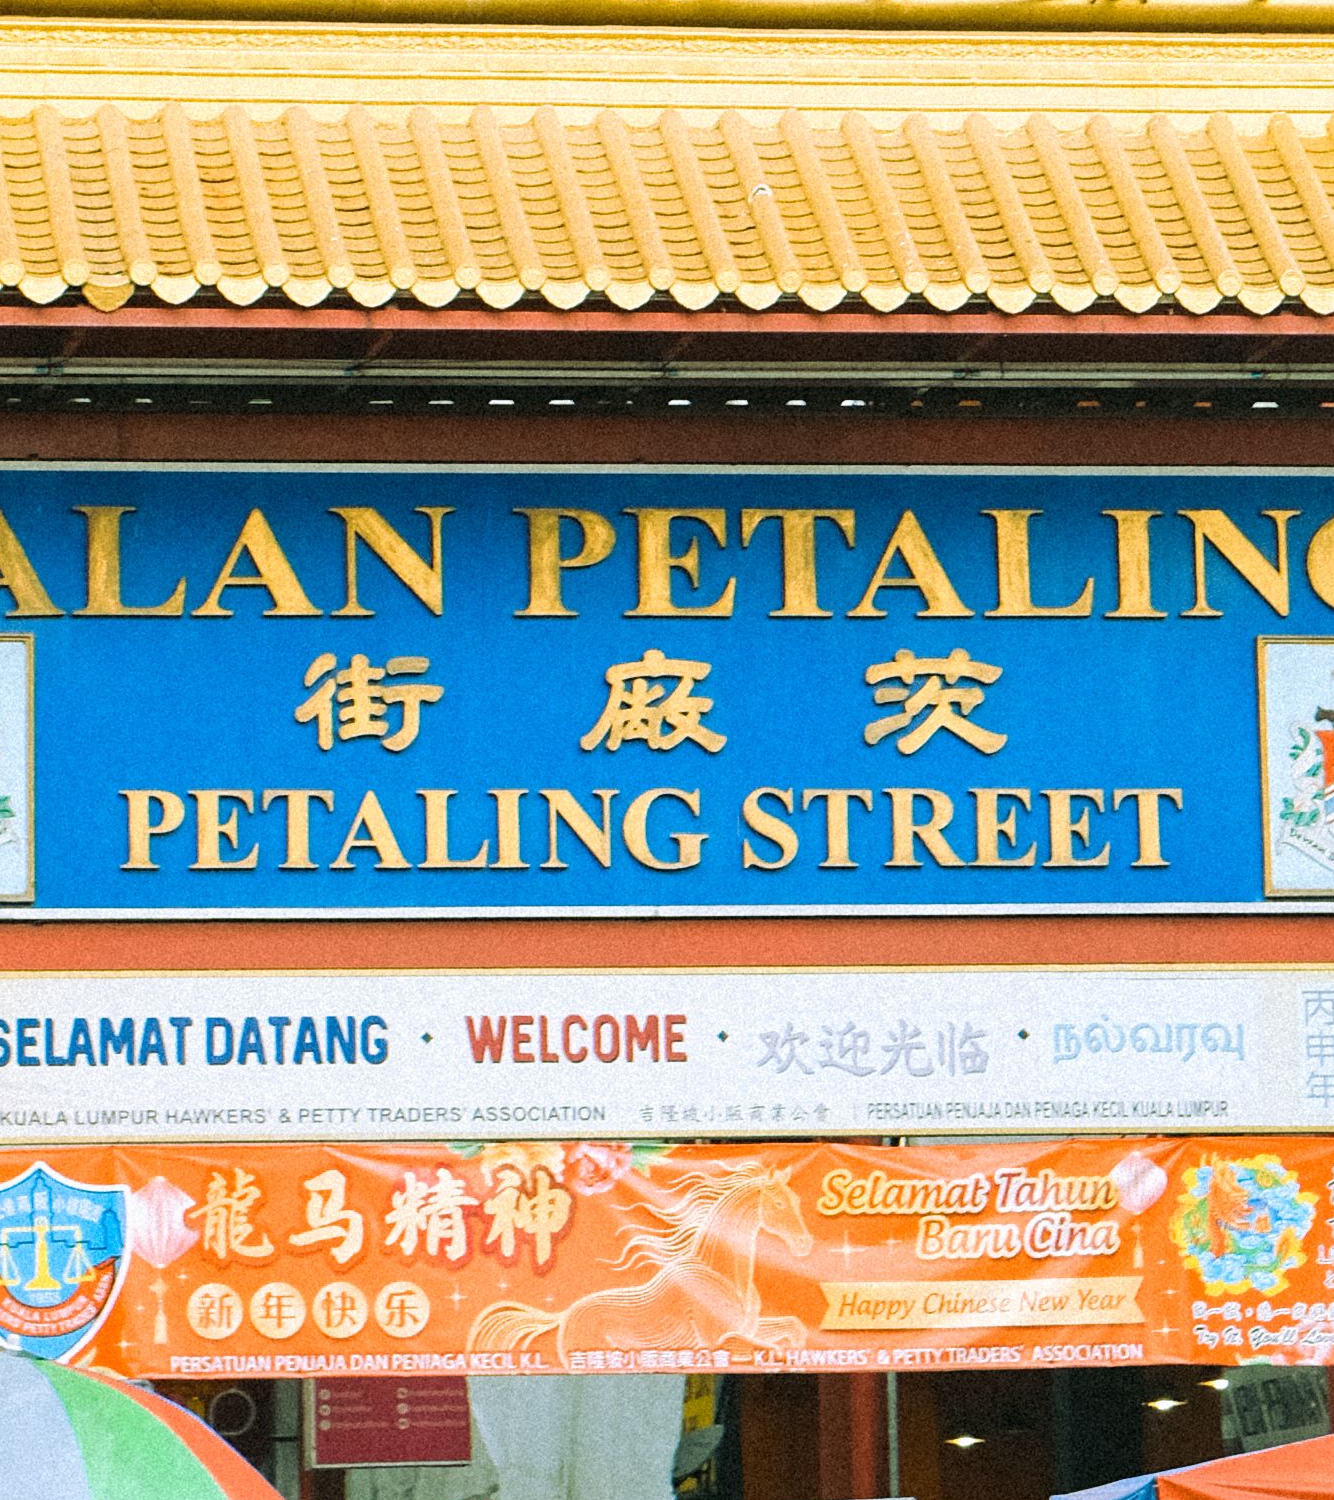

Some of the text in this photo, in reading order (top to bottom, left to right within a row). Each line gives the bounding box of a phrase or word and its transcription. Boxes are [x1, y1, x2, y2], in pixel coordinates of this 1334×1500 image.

[120, 784, 1184, 872] PETALING STREET
[204, 1014, 389, 1066] DATANG
[466, 1013, 689, 1064] WELCOME
[756, 1018, 990, 1078] 欢迎光临
[1052, 1013, 1245, 1063] நல்வரவு
[0, 1109, 69, 1127] KUALA
[74, 1108, 159, 1126] LUMPUR
[278, 1107, 291, 1124] &
[298, 1107, 361, 1124] PETTY
[471, 1104, 607, 1122] ASSOCIATION
[867, 1102, 943, 1121] PERSATUAN
[946, 1102, 1001, 1120] PENJAJA
[1004, 1102, 1031, 1120] DAN
[1034, 1101, 1090, 1120] PENIAGA
[1092, 1101, 1129, 1119] KECIL
[1132, 1101, 1174, 1118] KUALA
[1177, 1100, 1229, 1118] LUMPUR
[819, 1169, 1116, 1214] Selamat Tahun
[188, 1167, 573, 1266] 龍马精神
[918, 1213, 1119, 1258] Baru Cina
[197, 1289, 421, 1331] 新年快乐
[838, 1287, 1128, 1320] Happy Chinese New Year
[169, 1354, 271, 1373] PERSATUAN
[275, 1354, 347, 1372] PENJAJA
[350, 1353, 390, 1371] DAN
[392, 1352, 467, 1371] PENIAGA
[471, 1351, 518, 1370] KECIL
[876, 1347, 890, 1366] &
[893, 1346, 944, 1366] PETTY
[1031, 1343, 1144, 1362] ASSOCIATION
